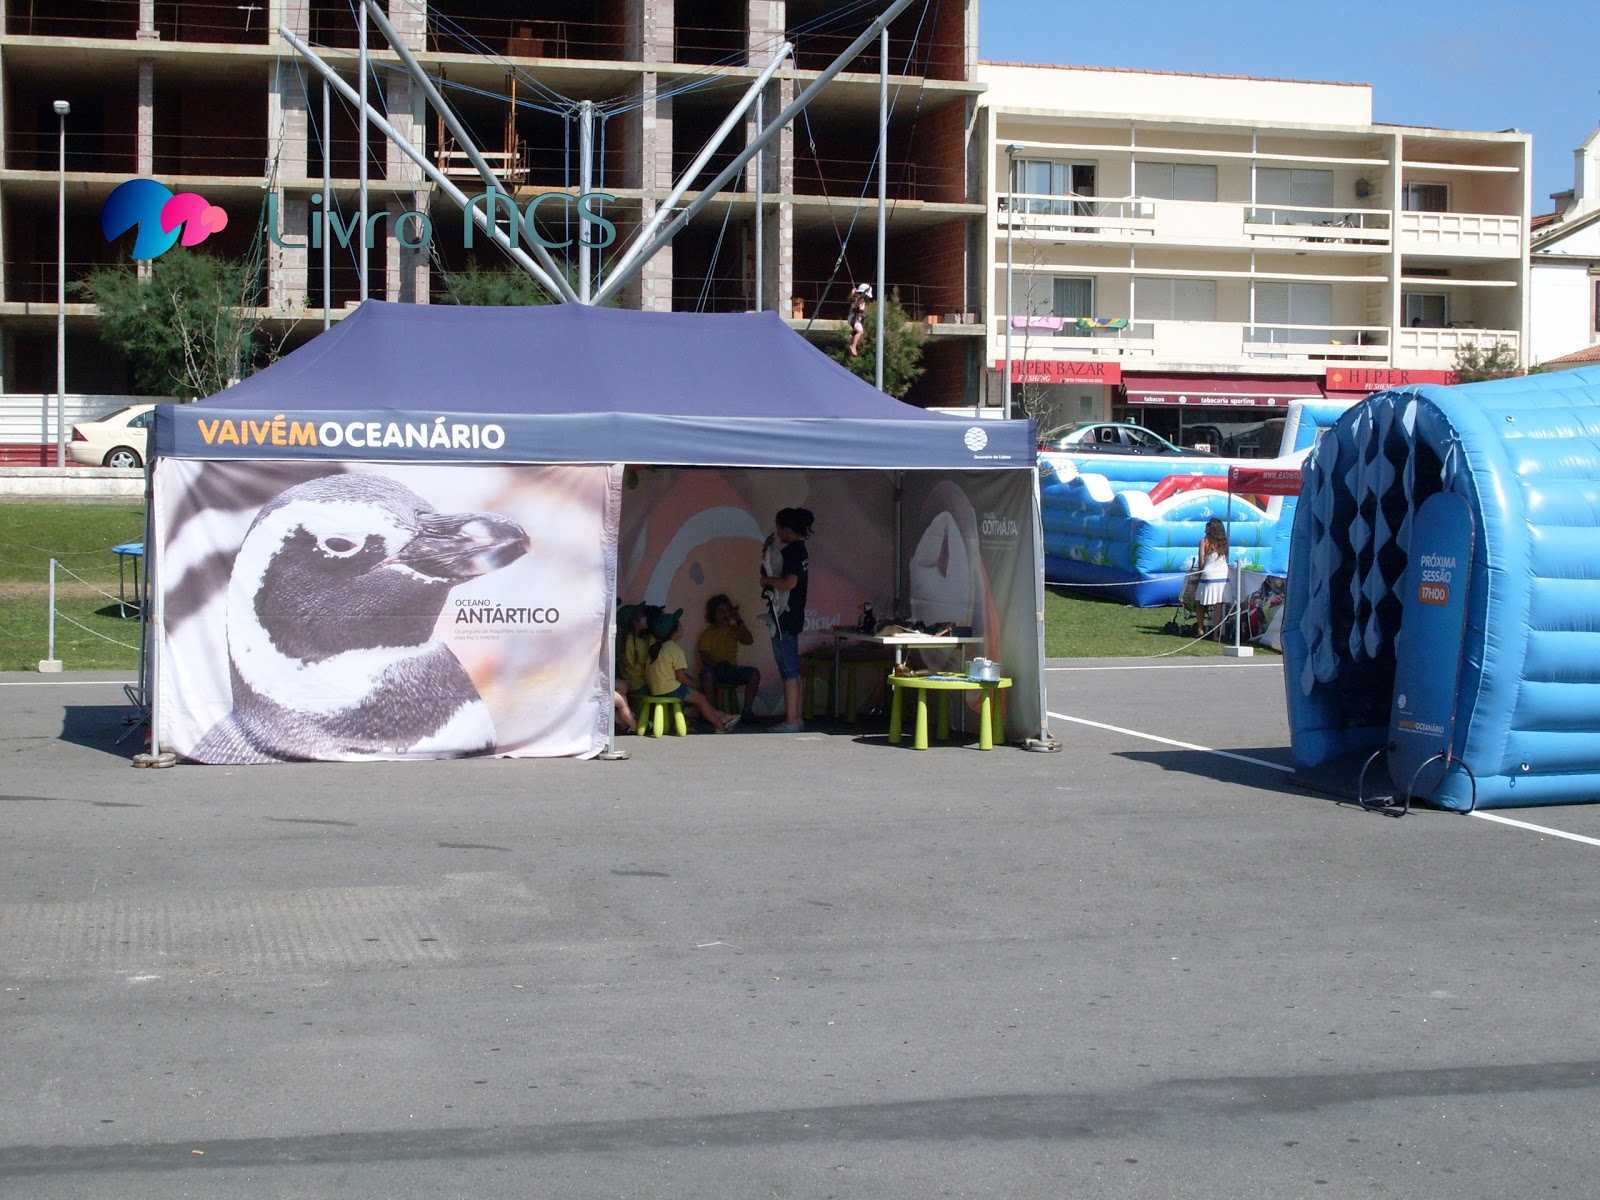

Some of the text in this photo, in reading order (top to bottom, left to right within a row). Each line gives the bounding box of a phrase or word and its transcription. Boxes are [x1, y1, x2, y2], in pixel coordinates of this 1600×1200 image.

[1011, 361, 1105, 376] HIPER BAZAR
[1028, 374, 1051, 383] SHENG
[1349, 369, 1410, 384] HIPER
[1144, 395, 1165, 403] tabacos
[1420, 552, 1456, 568] PRÓXIMA
[1421, 568, 1452, 583] SESSÃO
[1421, 586, 1446, 600] 17H00
[455, 599, 491, 607] OCEANO
[455, 603, 560, 624] ANTÁRTICO
